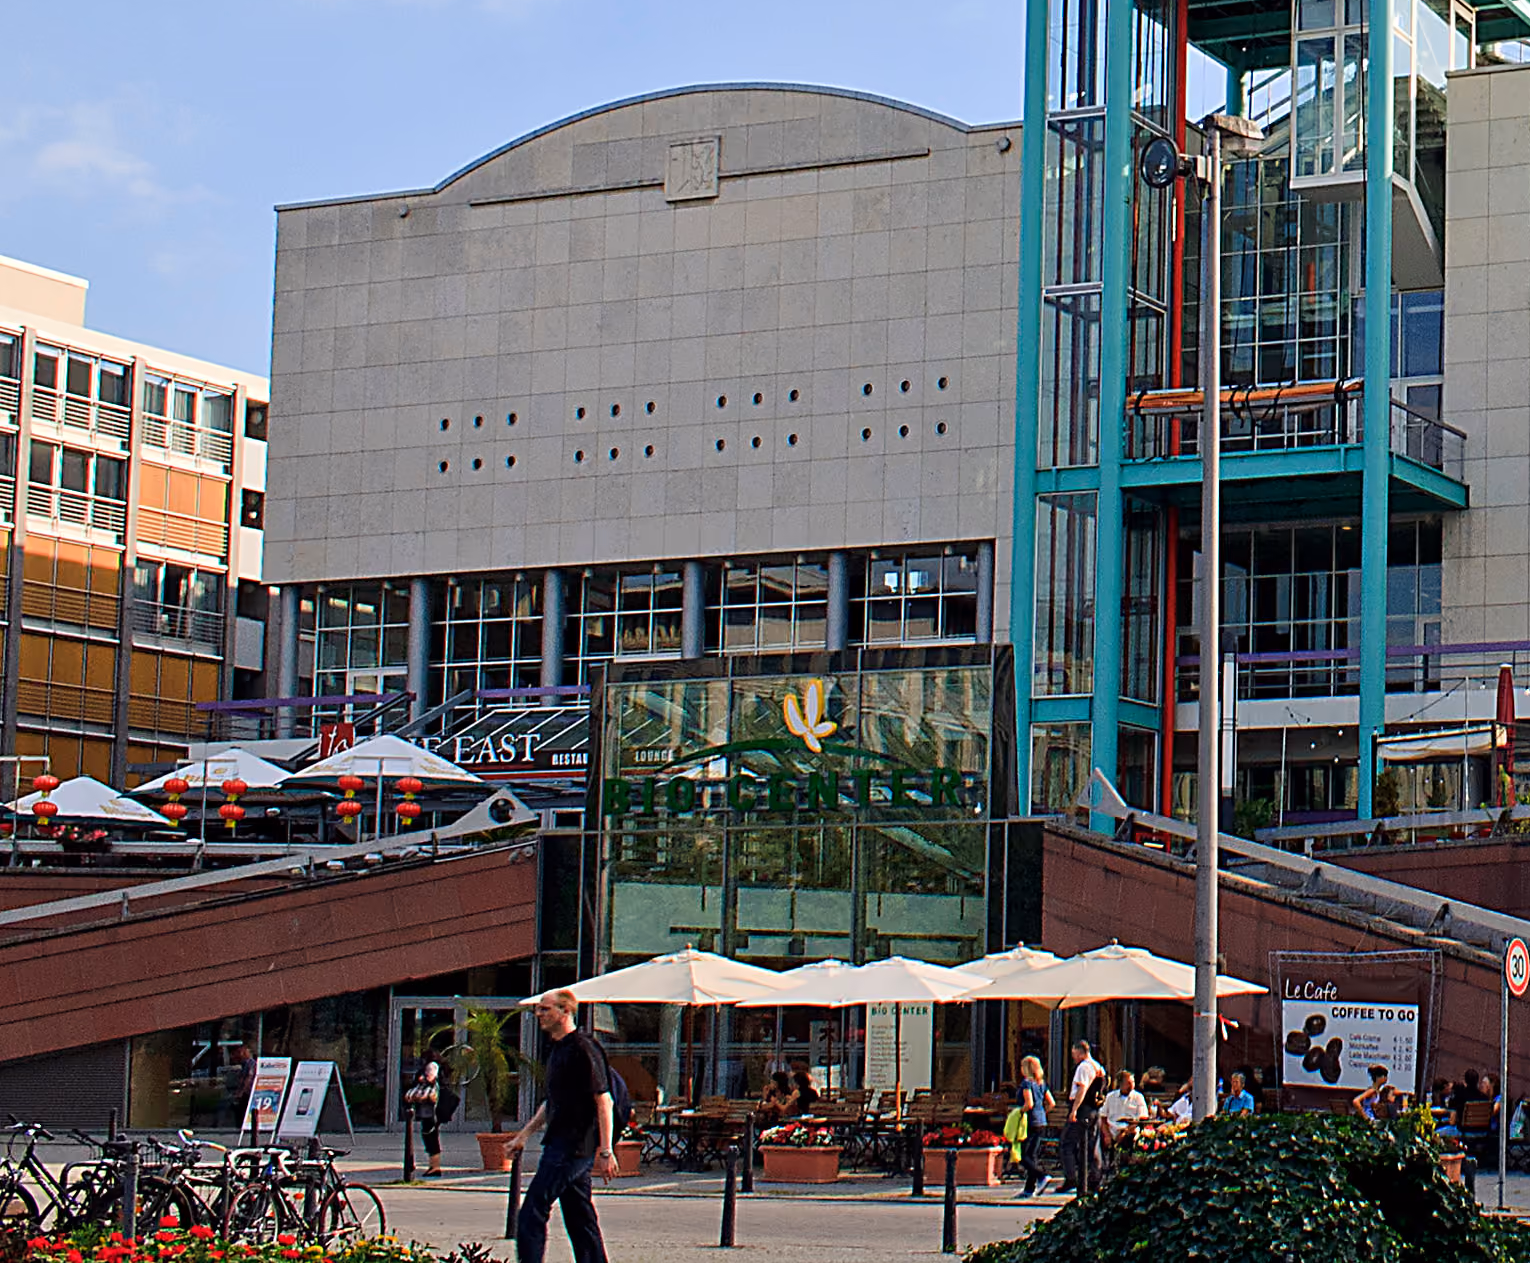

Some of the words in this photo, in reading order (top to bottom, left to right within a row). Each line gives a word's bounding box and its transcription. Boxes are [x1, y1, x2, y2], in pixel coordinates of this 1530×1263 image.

[454, 733, 540, 764] EAST
[552, 752, 589, 766] RESTAU
[635, 749, 675, 763] LOUNGE
[604, 777, 695, 815] BIO
[729, 768, 962, 812] CENTER
[1512, 955, 1524, 977] 30
[1285, 978, 1300, 999] Le
[871, 1006, 888, 1016] BIO
[891, 1007, 928, 1016] CNTER
[1332, 1007, 1375, 1019] COFFEE
[1378, 1009, 1394, 1020] TO
[1398, 1010, 1415, 1022] GO
[255, 1098, 273, 1110] 19
